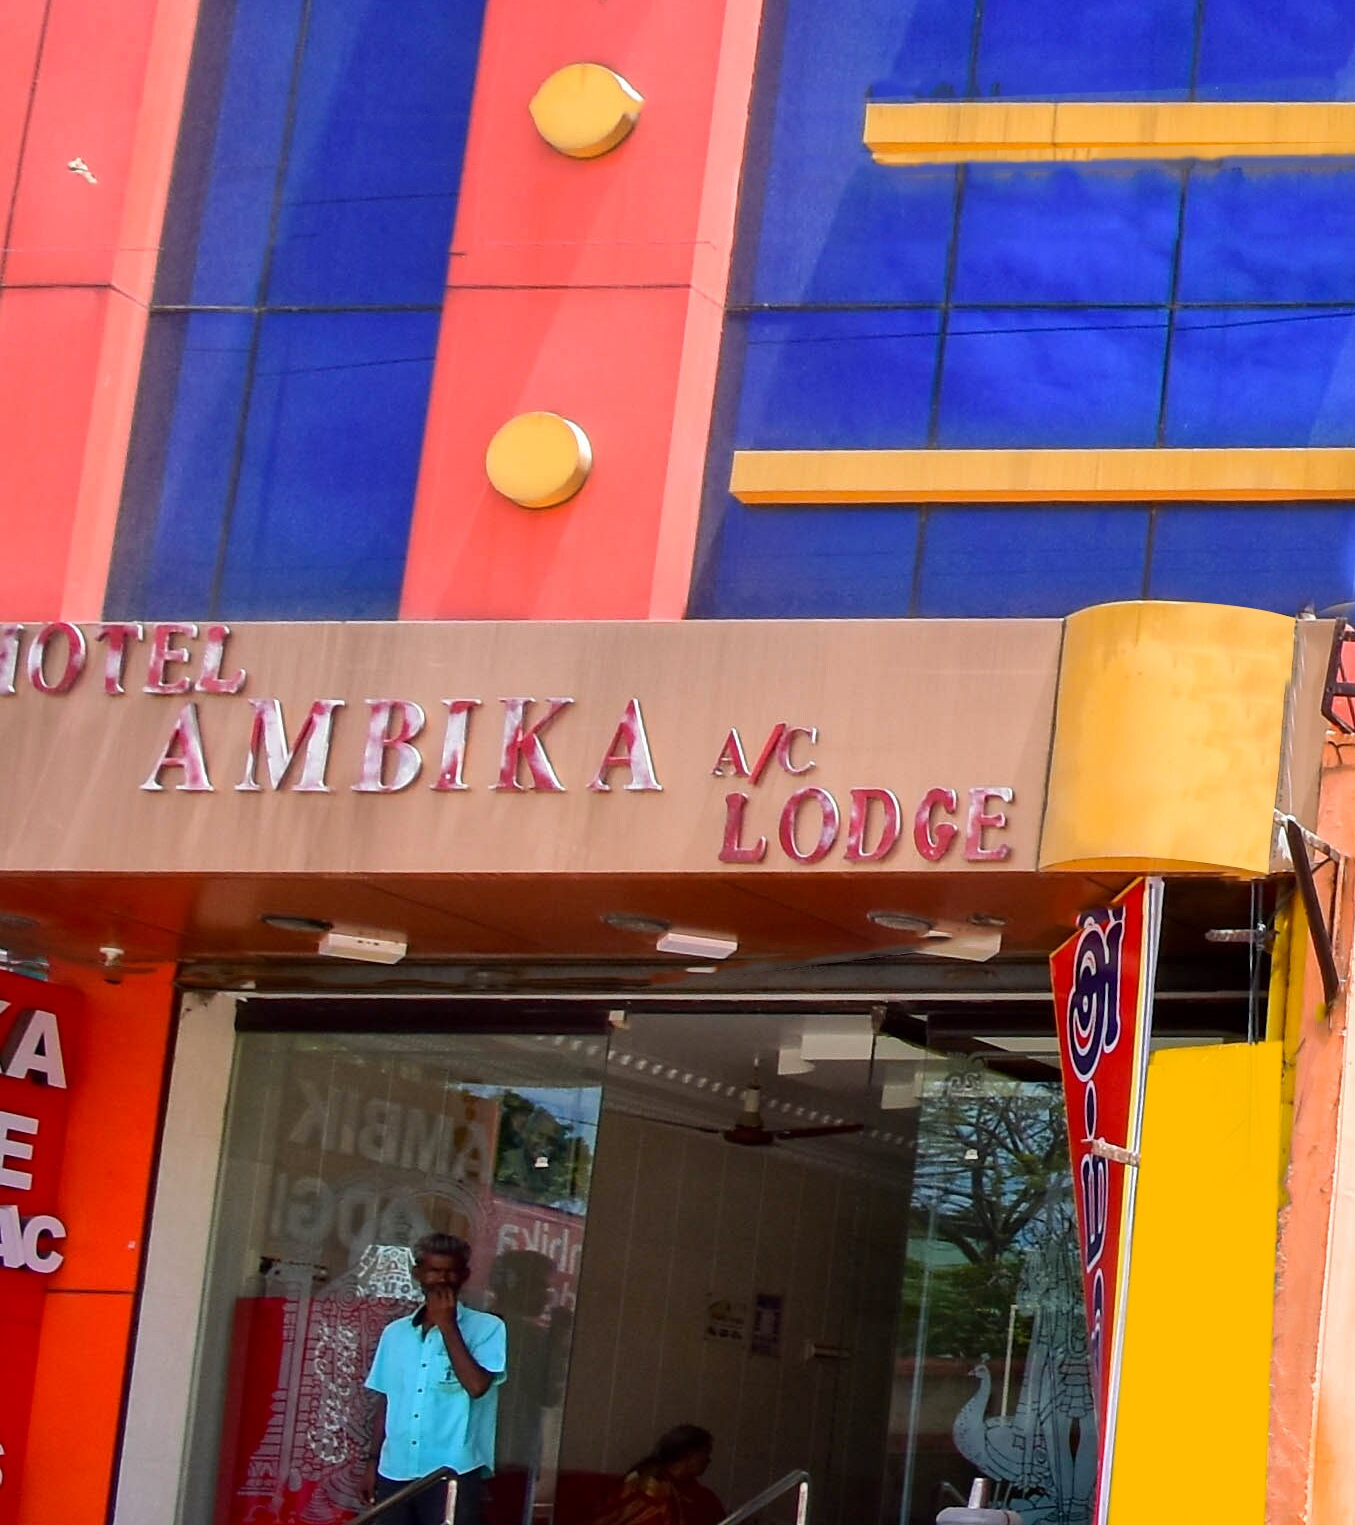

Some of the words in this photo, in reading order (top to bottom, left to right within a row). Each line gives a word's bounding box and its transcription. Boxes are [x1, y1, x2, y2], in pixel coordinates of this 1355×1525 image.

[139, 698, 663, 792] AMBIKA
[712, 723, 817, 785] A/C
[718, 787, 1014, 864] LODGE
